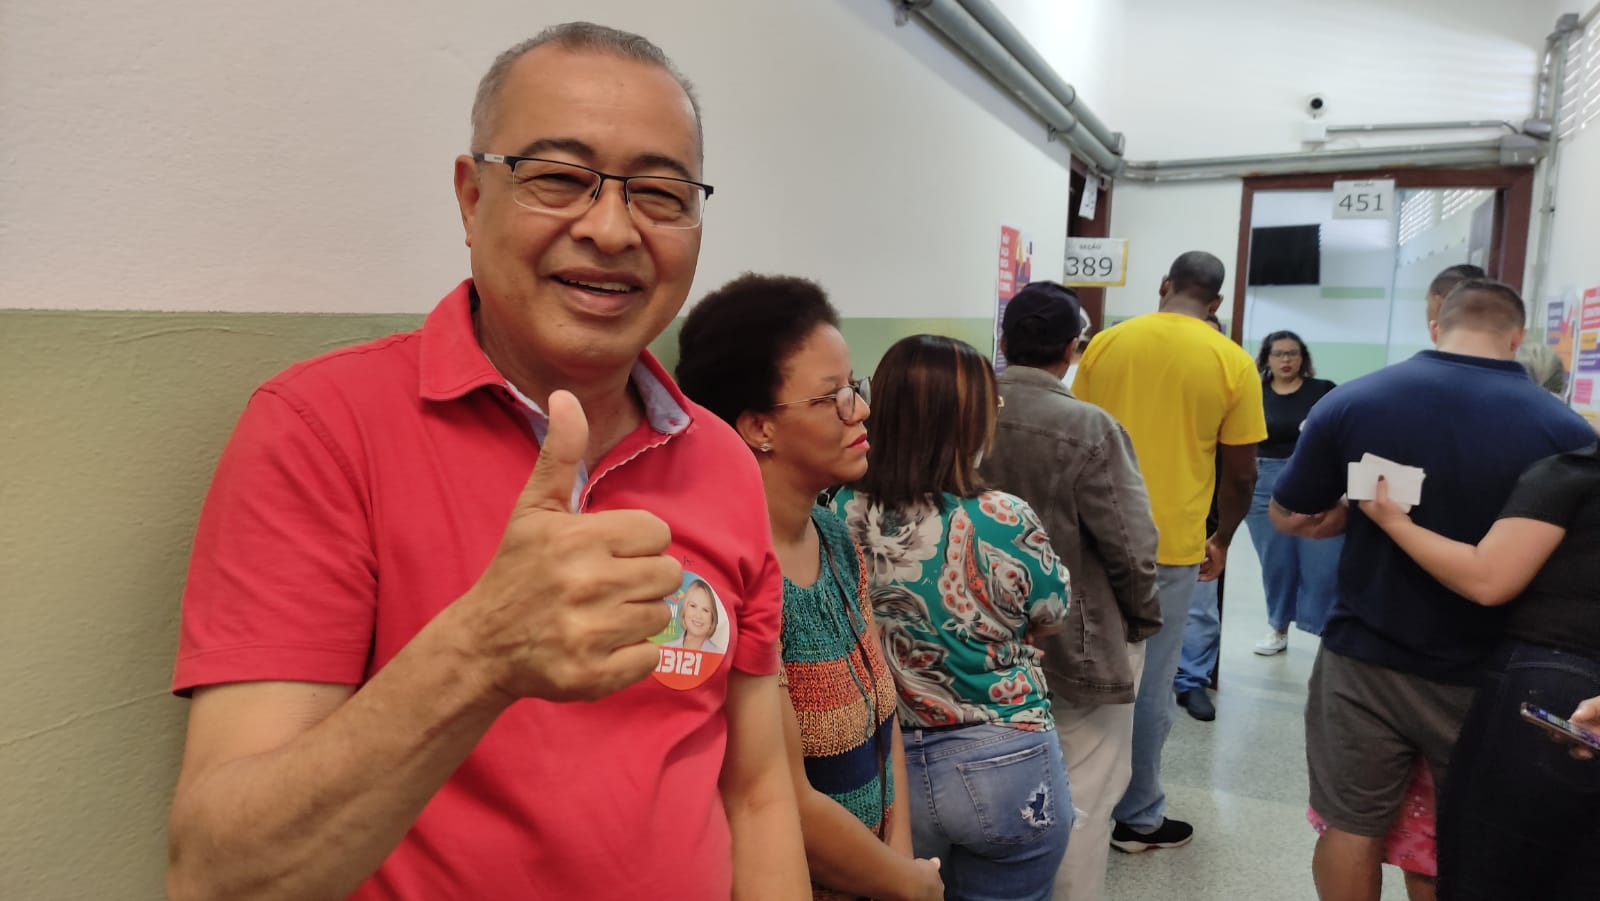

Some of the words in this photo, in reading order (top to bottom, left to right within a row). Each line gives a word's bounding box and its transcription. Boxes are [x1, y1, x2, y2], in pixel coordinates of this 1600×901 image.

[1338, 194, 1384, 212] 451
[1065, 256, 1113, 277] 389
[655, 649, 703, 676] 13121
